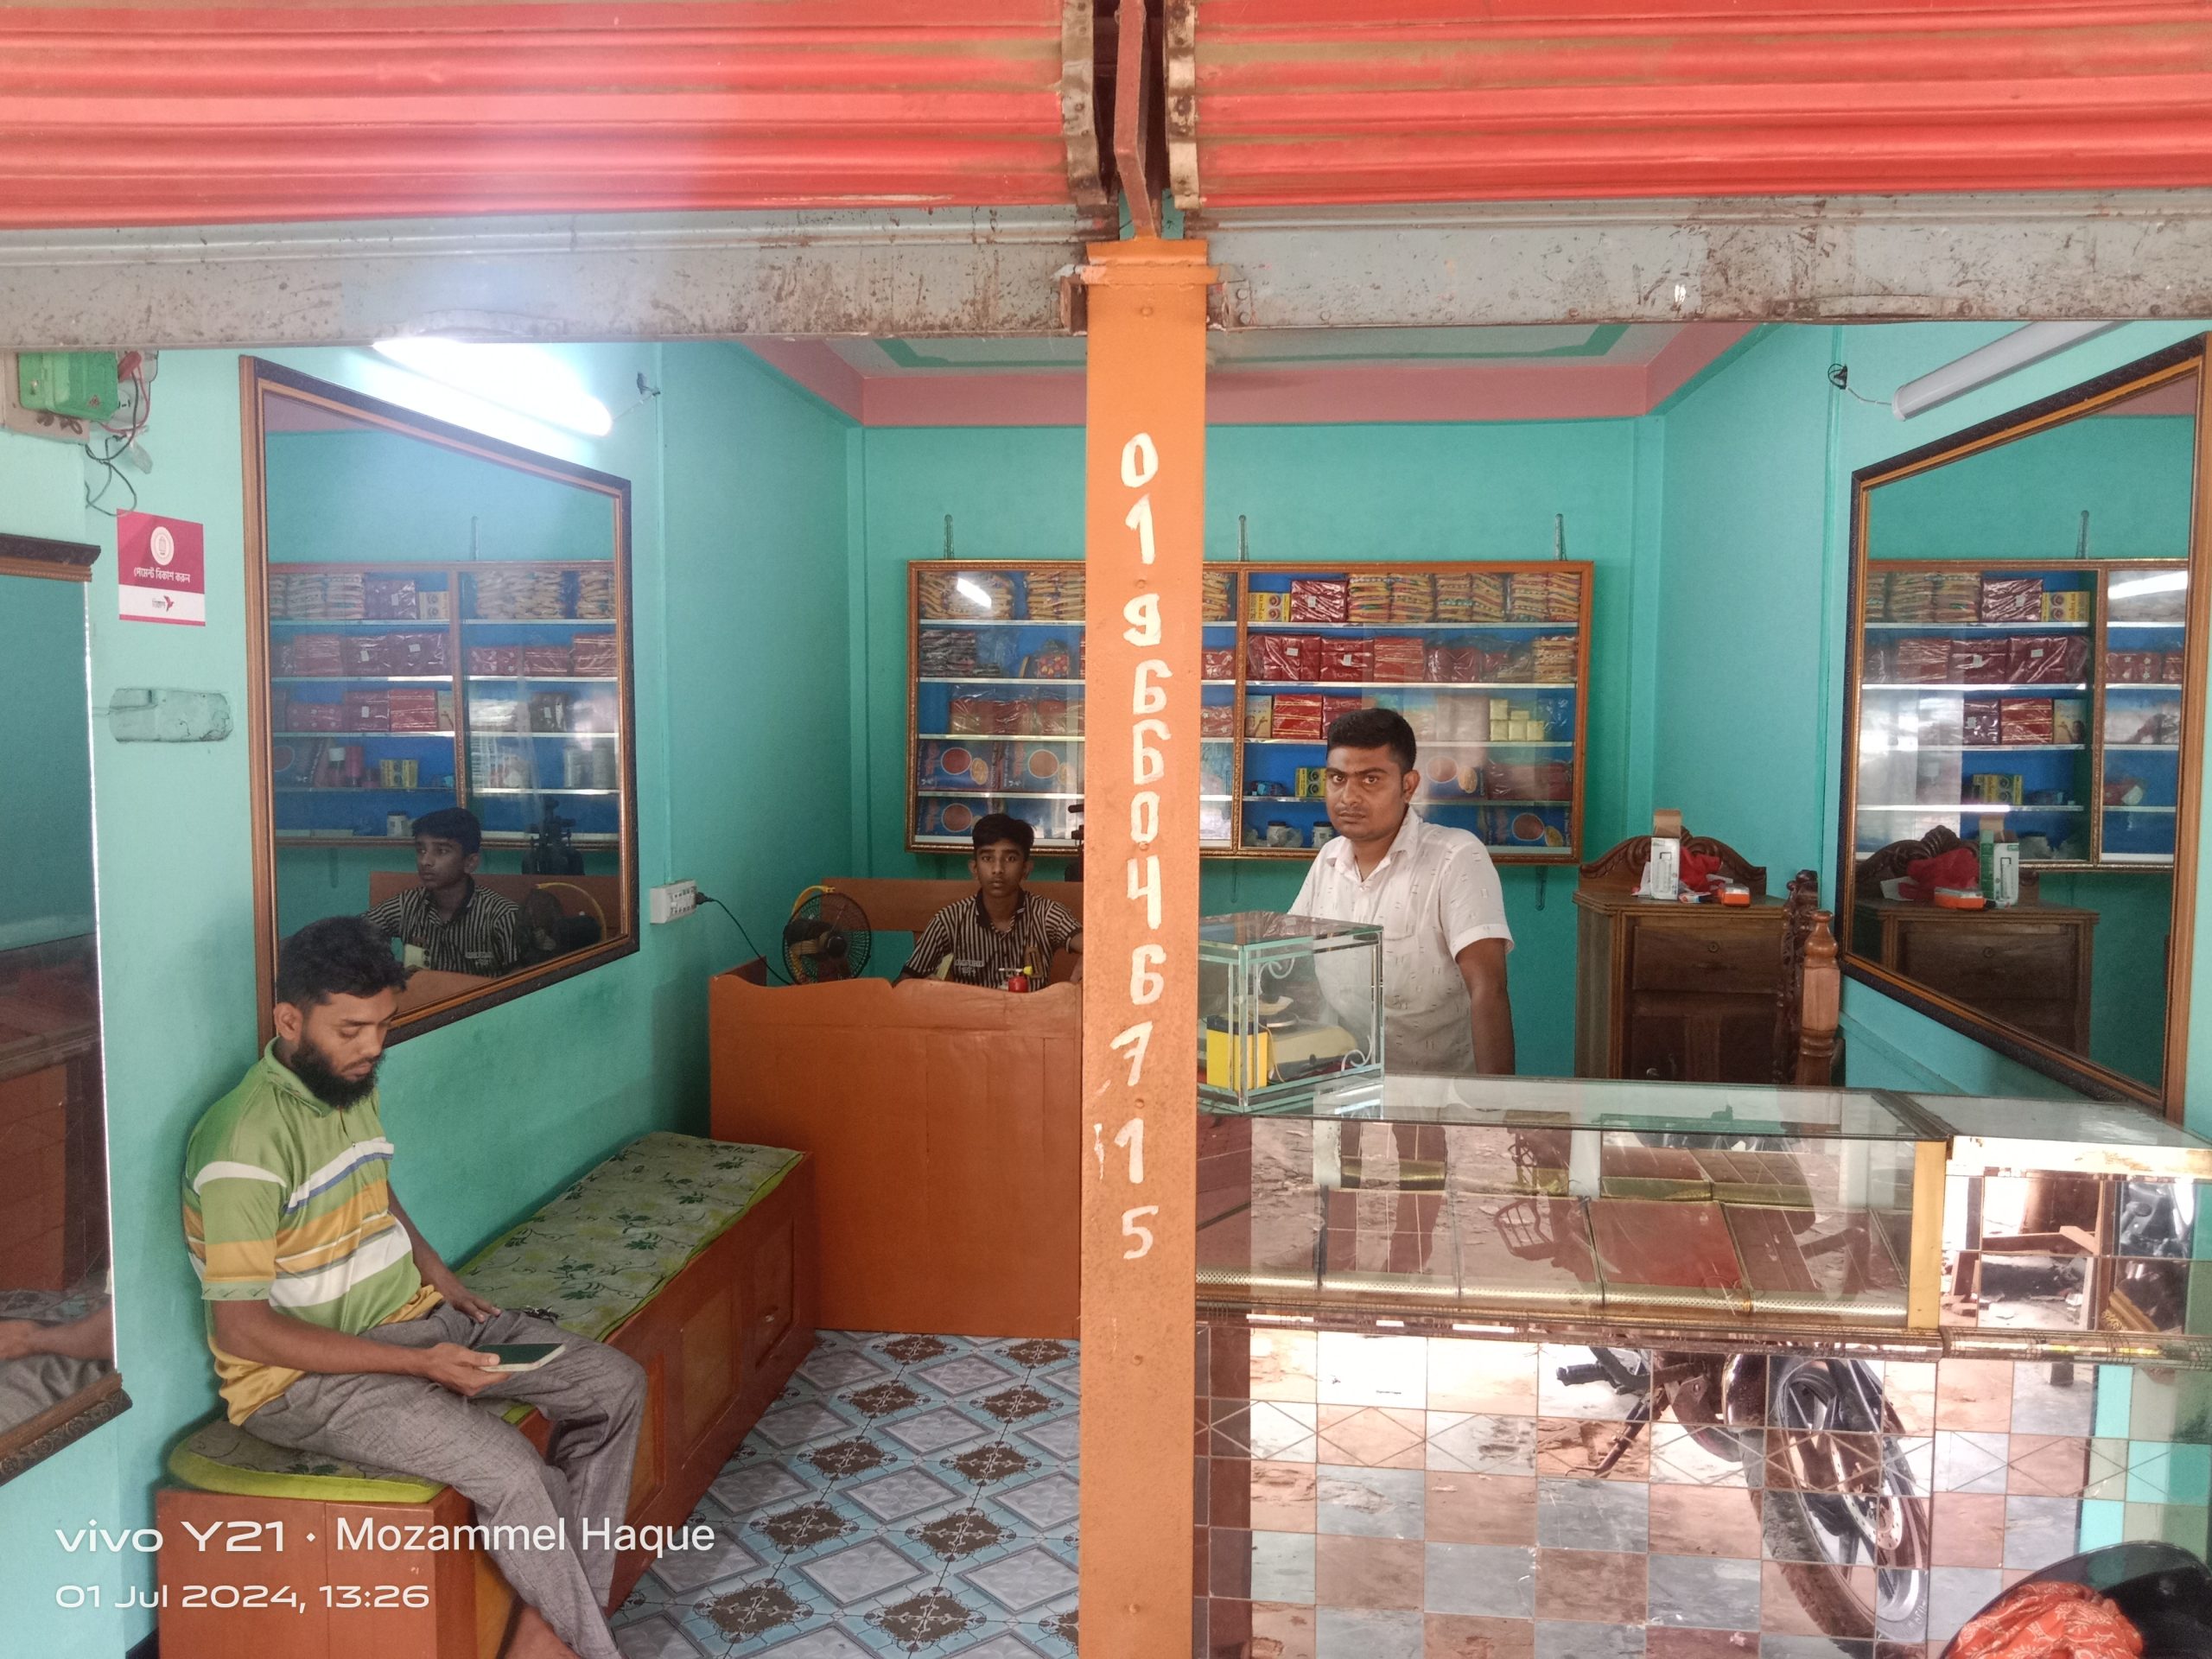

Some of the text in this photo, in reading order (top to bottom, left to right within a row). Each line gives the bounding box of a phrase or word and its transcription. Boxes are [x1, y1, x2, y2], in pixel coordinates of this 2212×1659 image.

[134, 566, 190, 582] পেমেন্ট বিকাশ করুন
